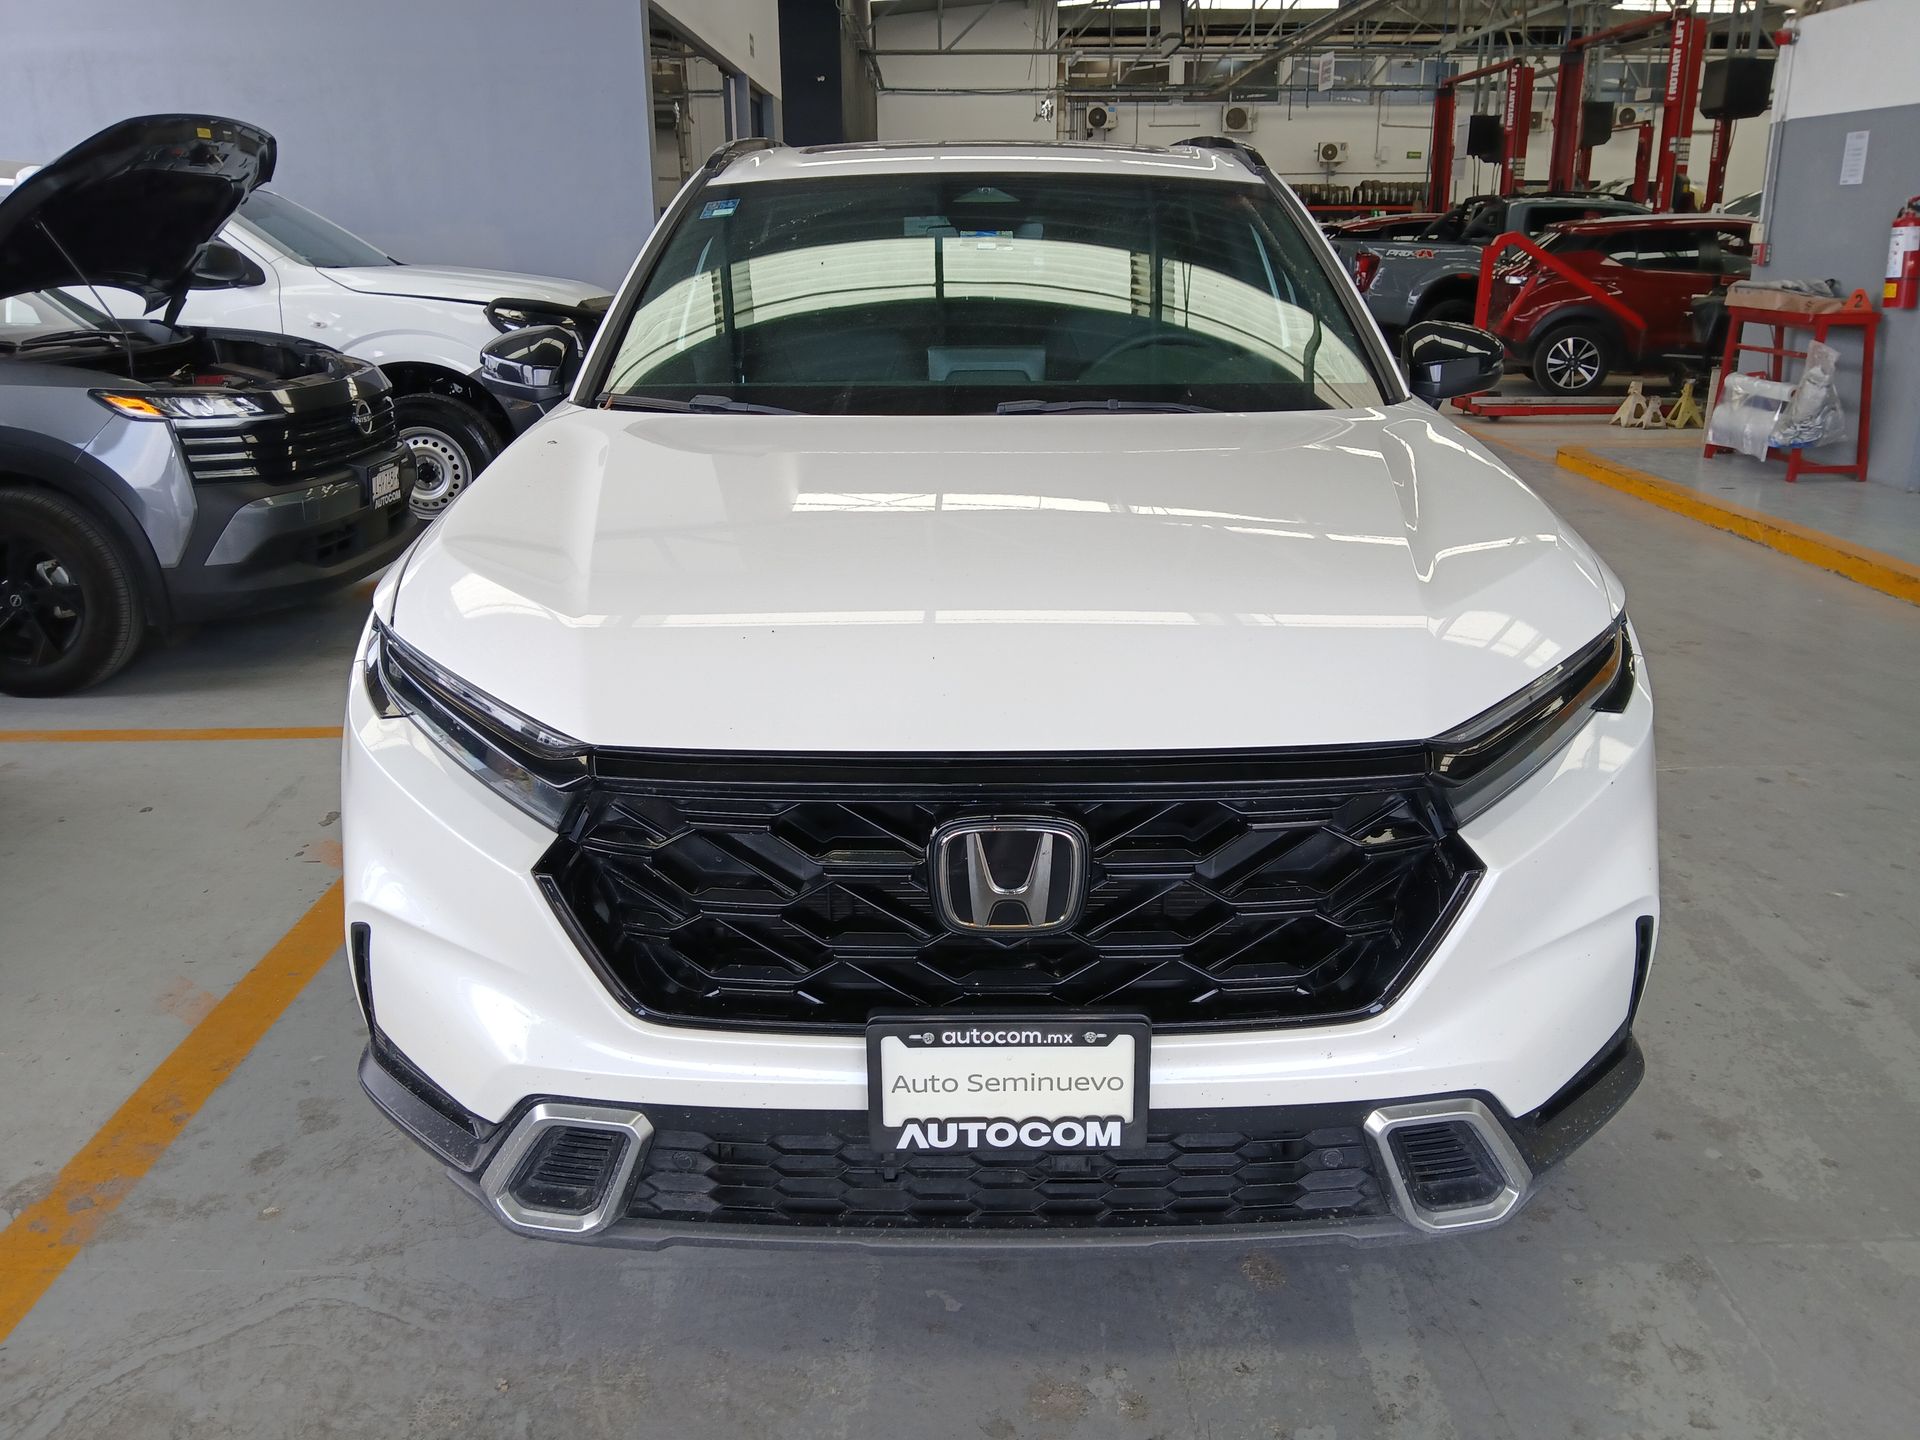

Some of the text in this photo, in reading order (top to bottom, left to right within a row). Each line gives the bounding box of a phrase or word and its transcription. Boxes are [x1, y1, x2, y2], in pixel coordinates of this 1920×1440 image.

[1668, 20, 1686, 95] ROTARY LIFT
[1506, 67, 1518, 127] ROTARY LIFT
[1854, 294, 1863, 308] 2
[374, 489, 401, 510] AUTOCOM
[942, 1028, 1073, 1045] autocom.mx
[891, 1073, 1124, 1094] Auto Seminuevo
[896, 1121, 1121, 1150] AUTOCOM
